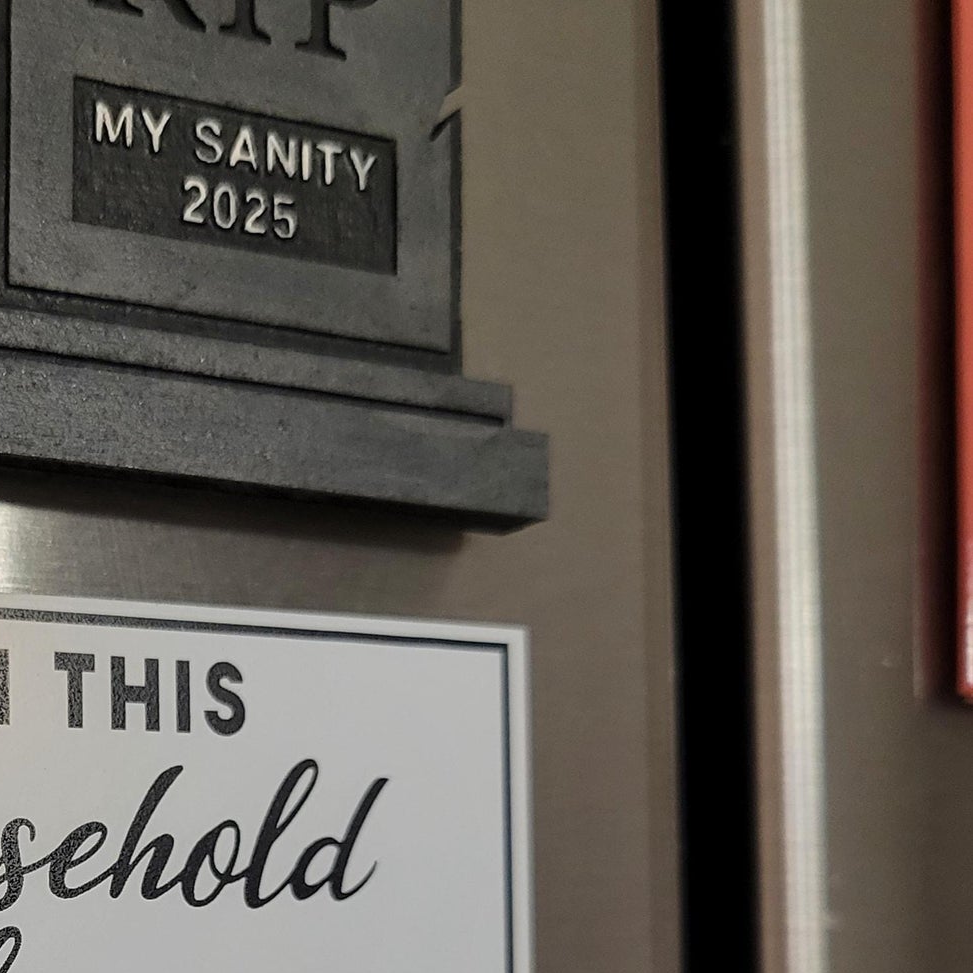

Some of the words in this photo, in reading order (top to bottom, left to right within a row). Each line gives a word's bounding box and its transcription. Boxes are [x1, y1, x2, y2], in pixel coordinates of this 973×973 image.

[94, 100, 171, 153] MY
[195, 117, 377, 191] SANITY
[182, 175, 298, 239] 2025
[53, 650, 247, 737] THIS
